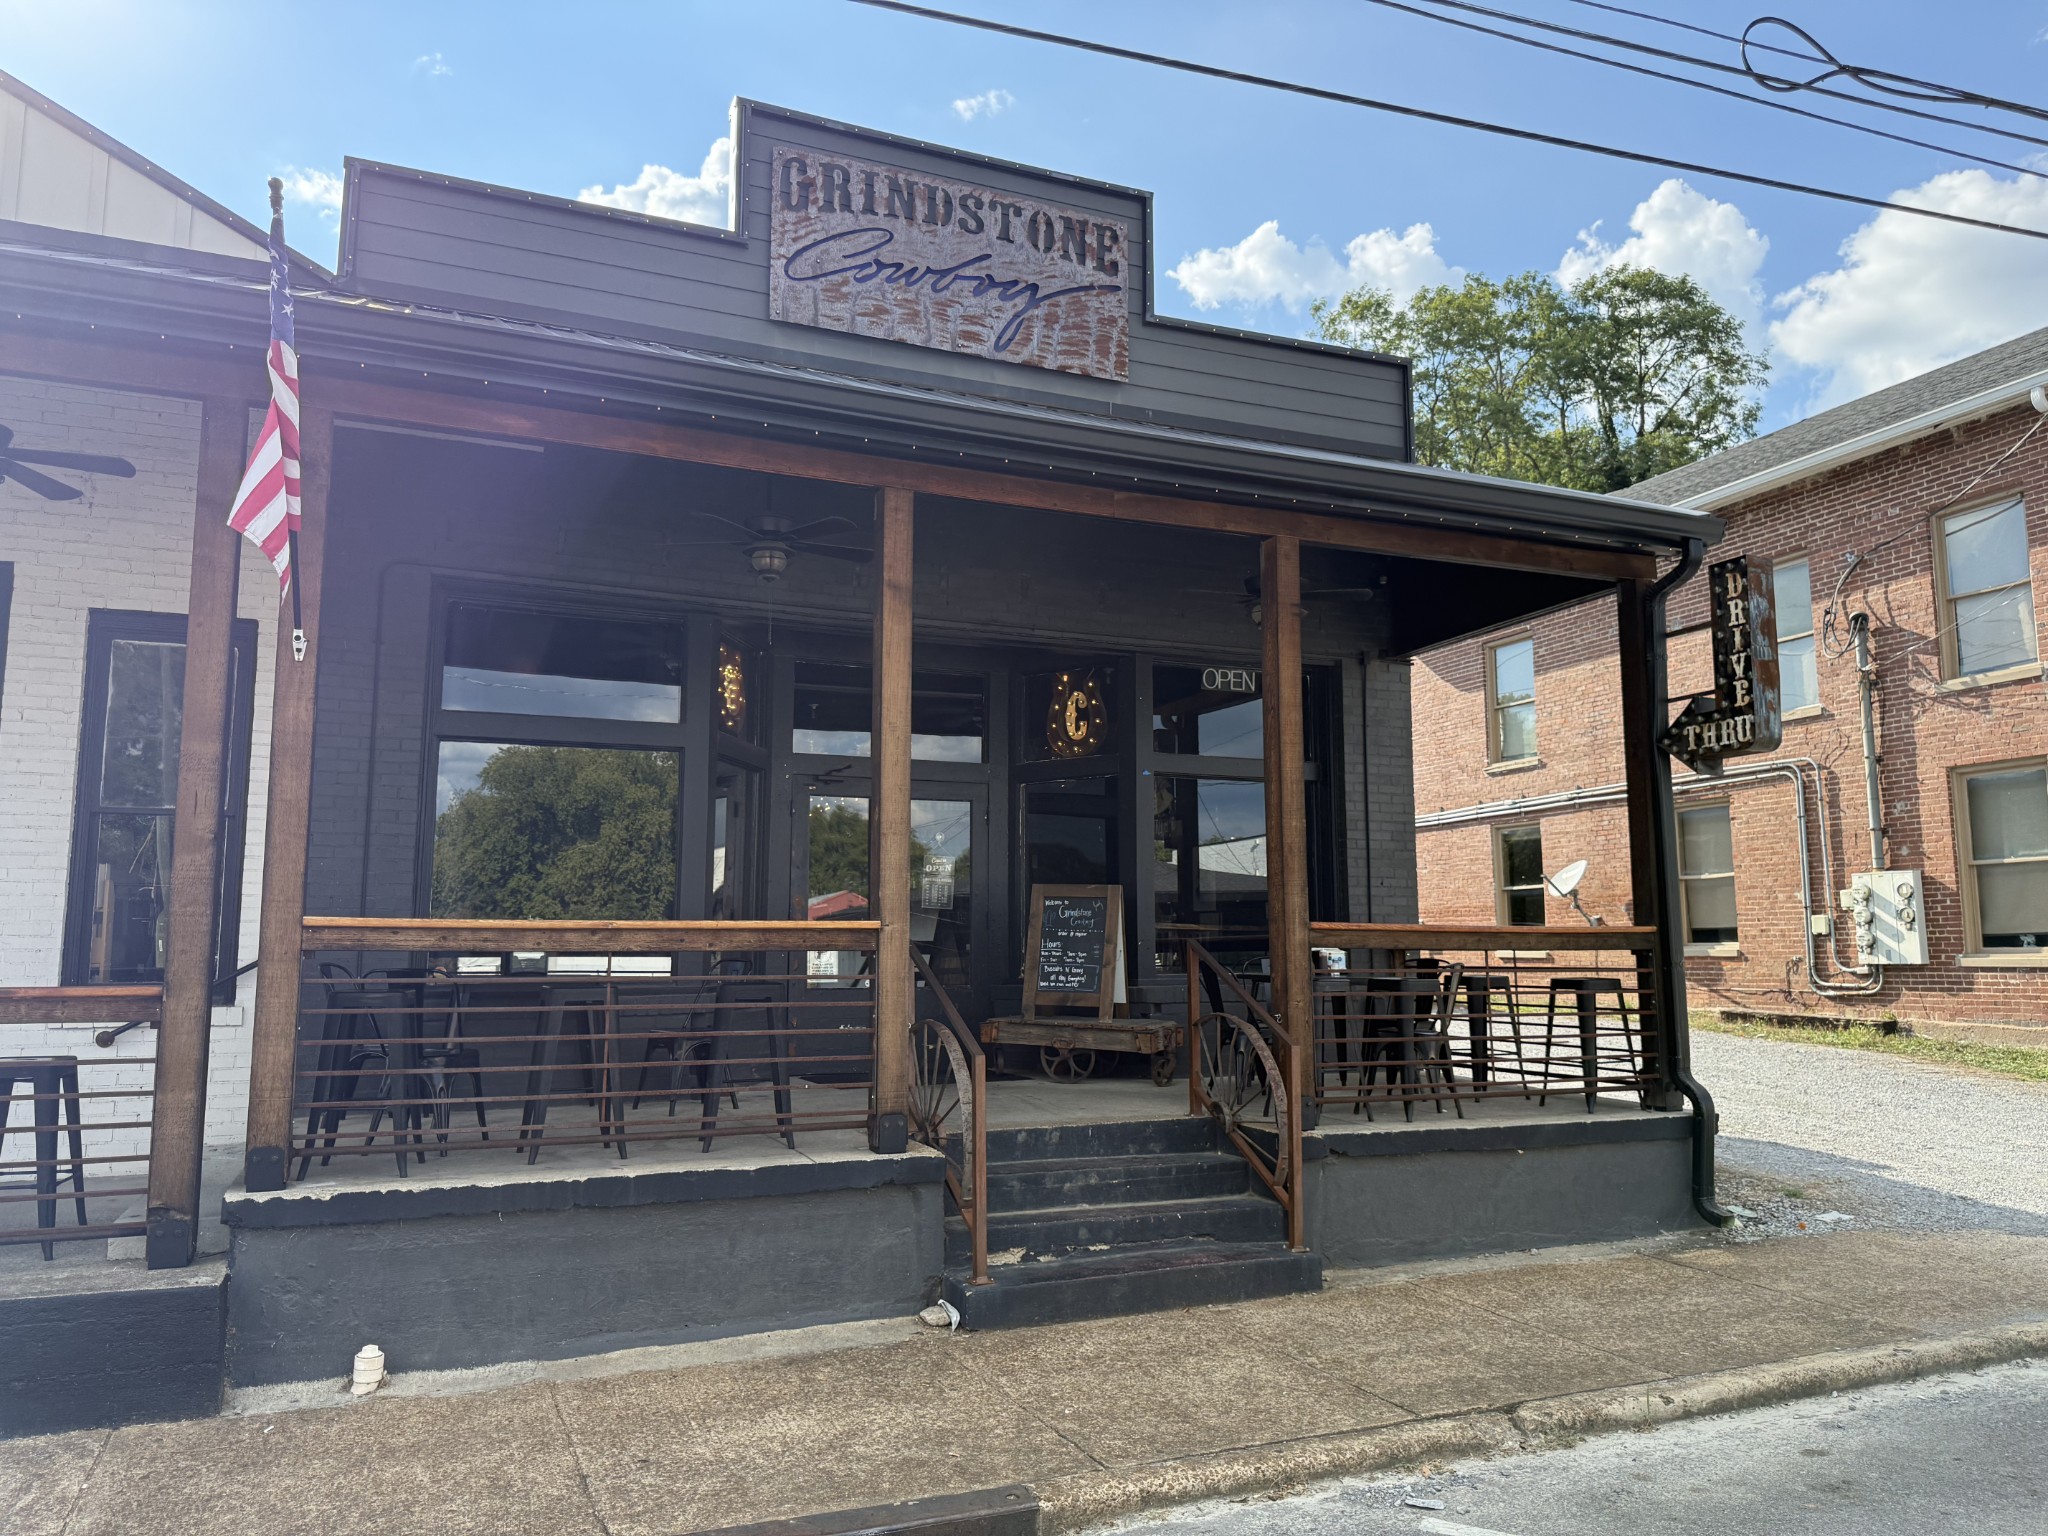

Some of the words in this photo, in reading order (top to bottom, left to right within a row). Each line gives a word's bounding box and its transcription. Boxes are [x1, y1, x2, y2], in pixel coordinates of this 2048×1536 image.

[779, 156, 1119, 277] GRINDSTONE
[783, 227, 1122, 353] Cowboy
[1725, 572, 1750, 708] DRIVE
[1202, 667, 1256, 692] OPEN
[1064, 691, 1088, 741] C
[1682, 714, 1753, 751] THRU
[925, 864, 953, 872] OPEN
[1059, 906, 1092, 918] Grindstone
